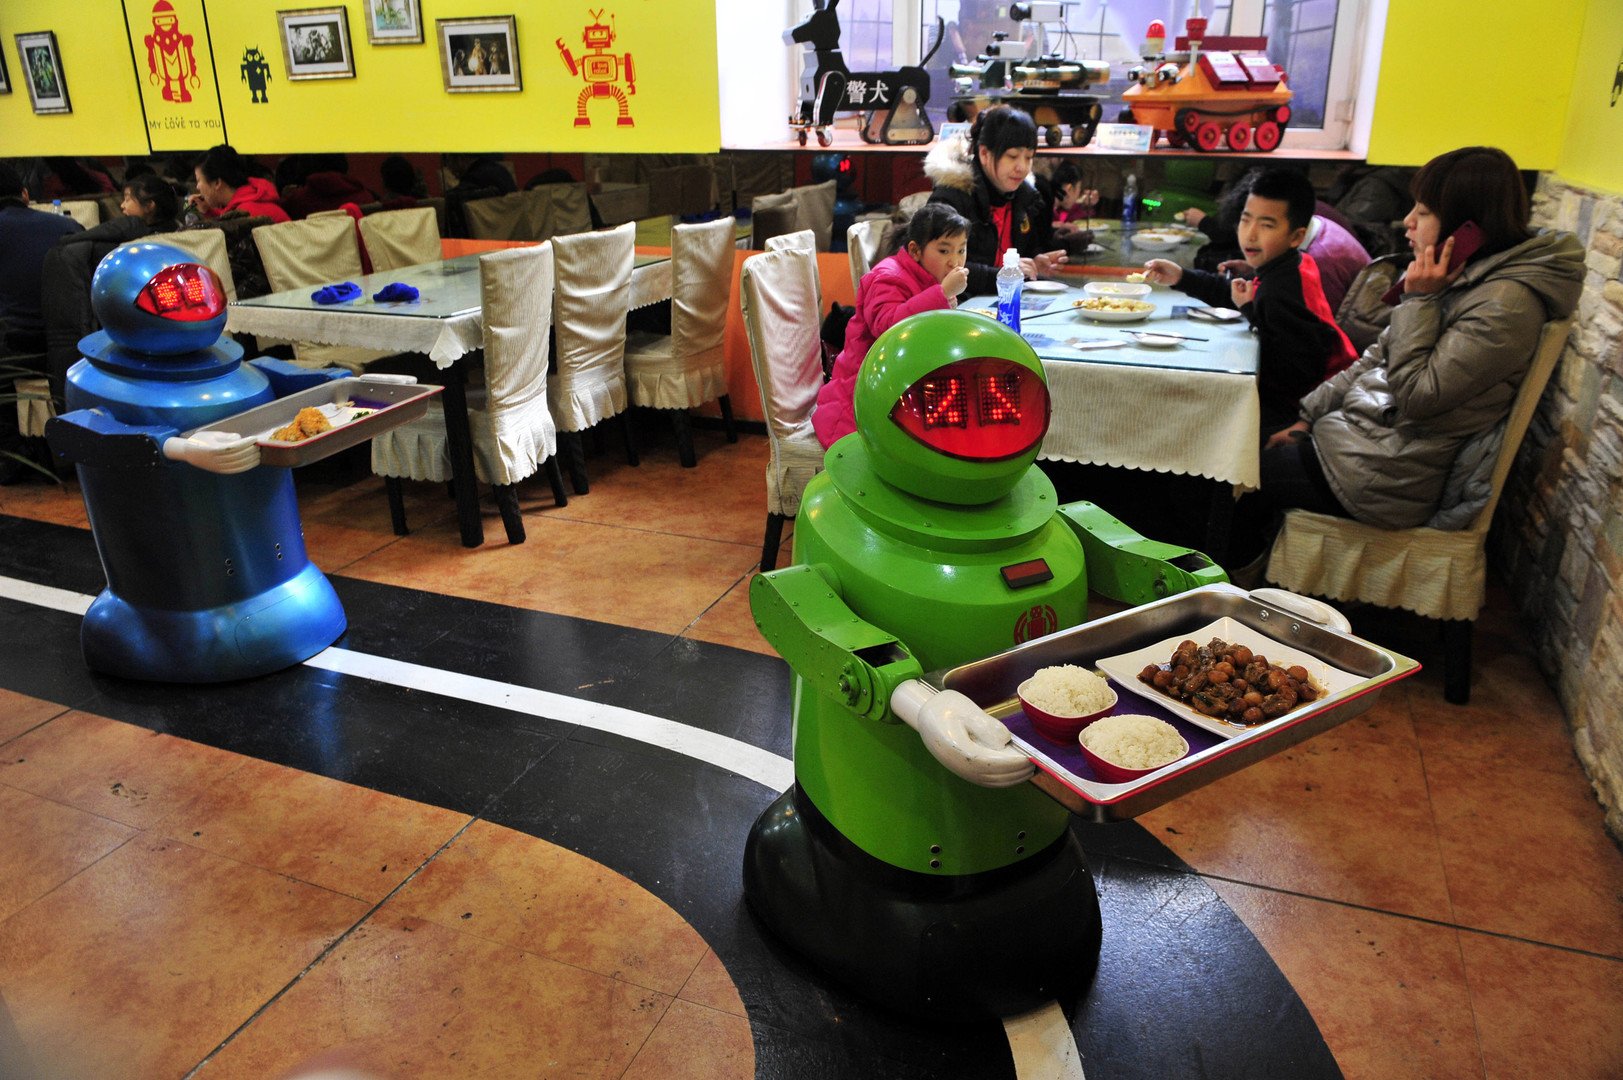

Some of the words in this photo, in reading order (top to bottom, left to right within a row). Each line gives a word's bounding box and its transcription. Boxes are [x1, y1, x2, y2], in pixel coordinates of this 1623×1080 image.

[847, 80, 889, 104] 警犬
[149, 120, 161, 129] MY
[165, 118, 185, 129] LOVE
[189, 120, 200, 128] TO
[204, 119, 221, 128] YOU
